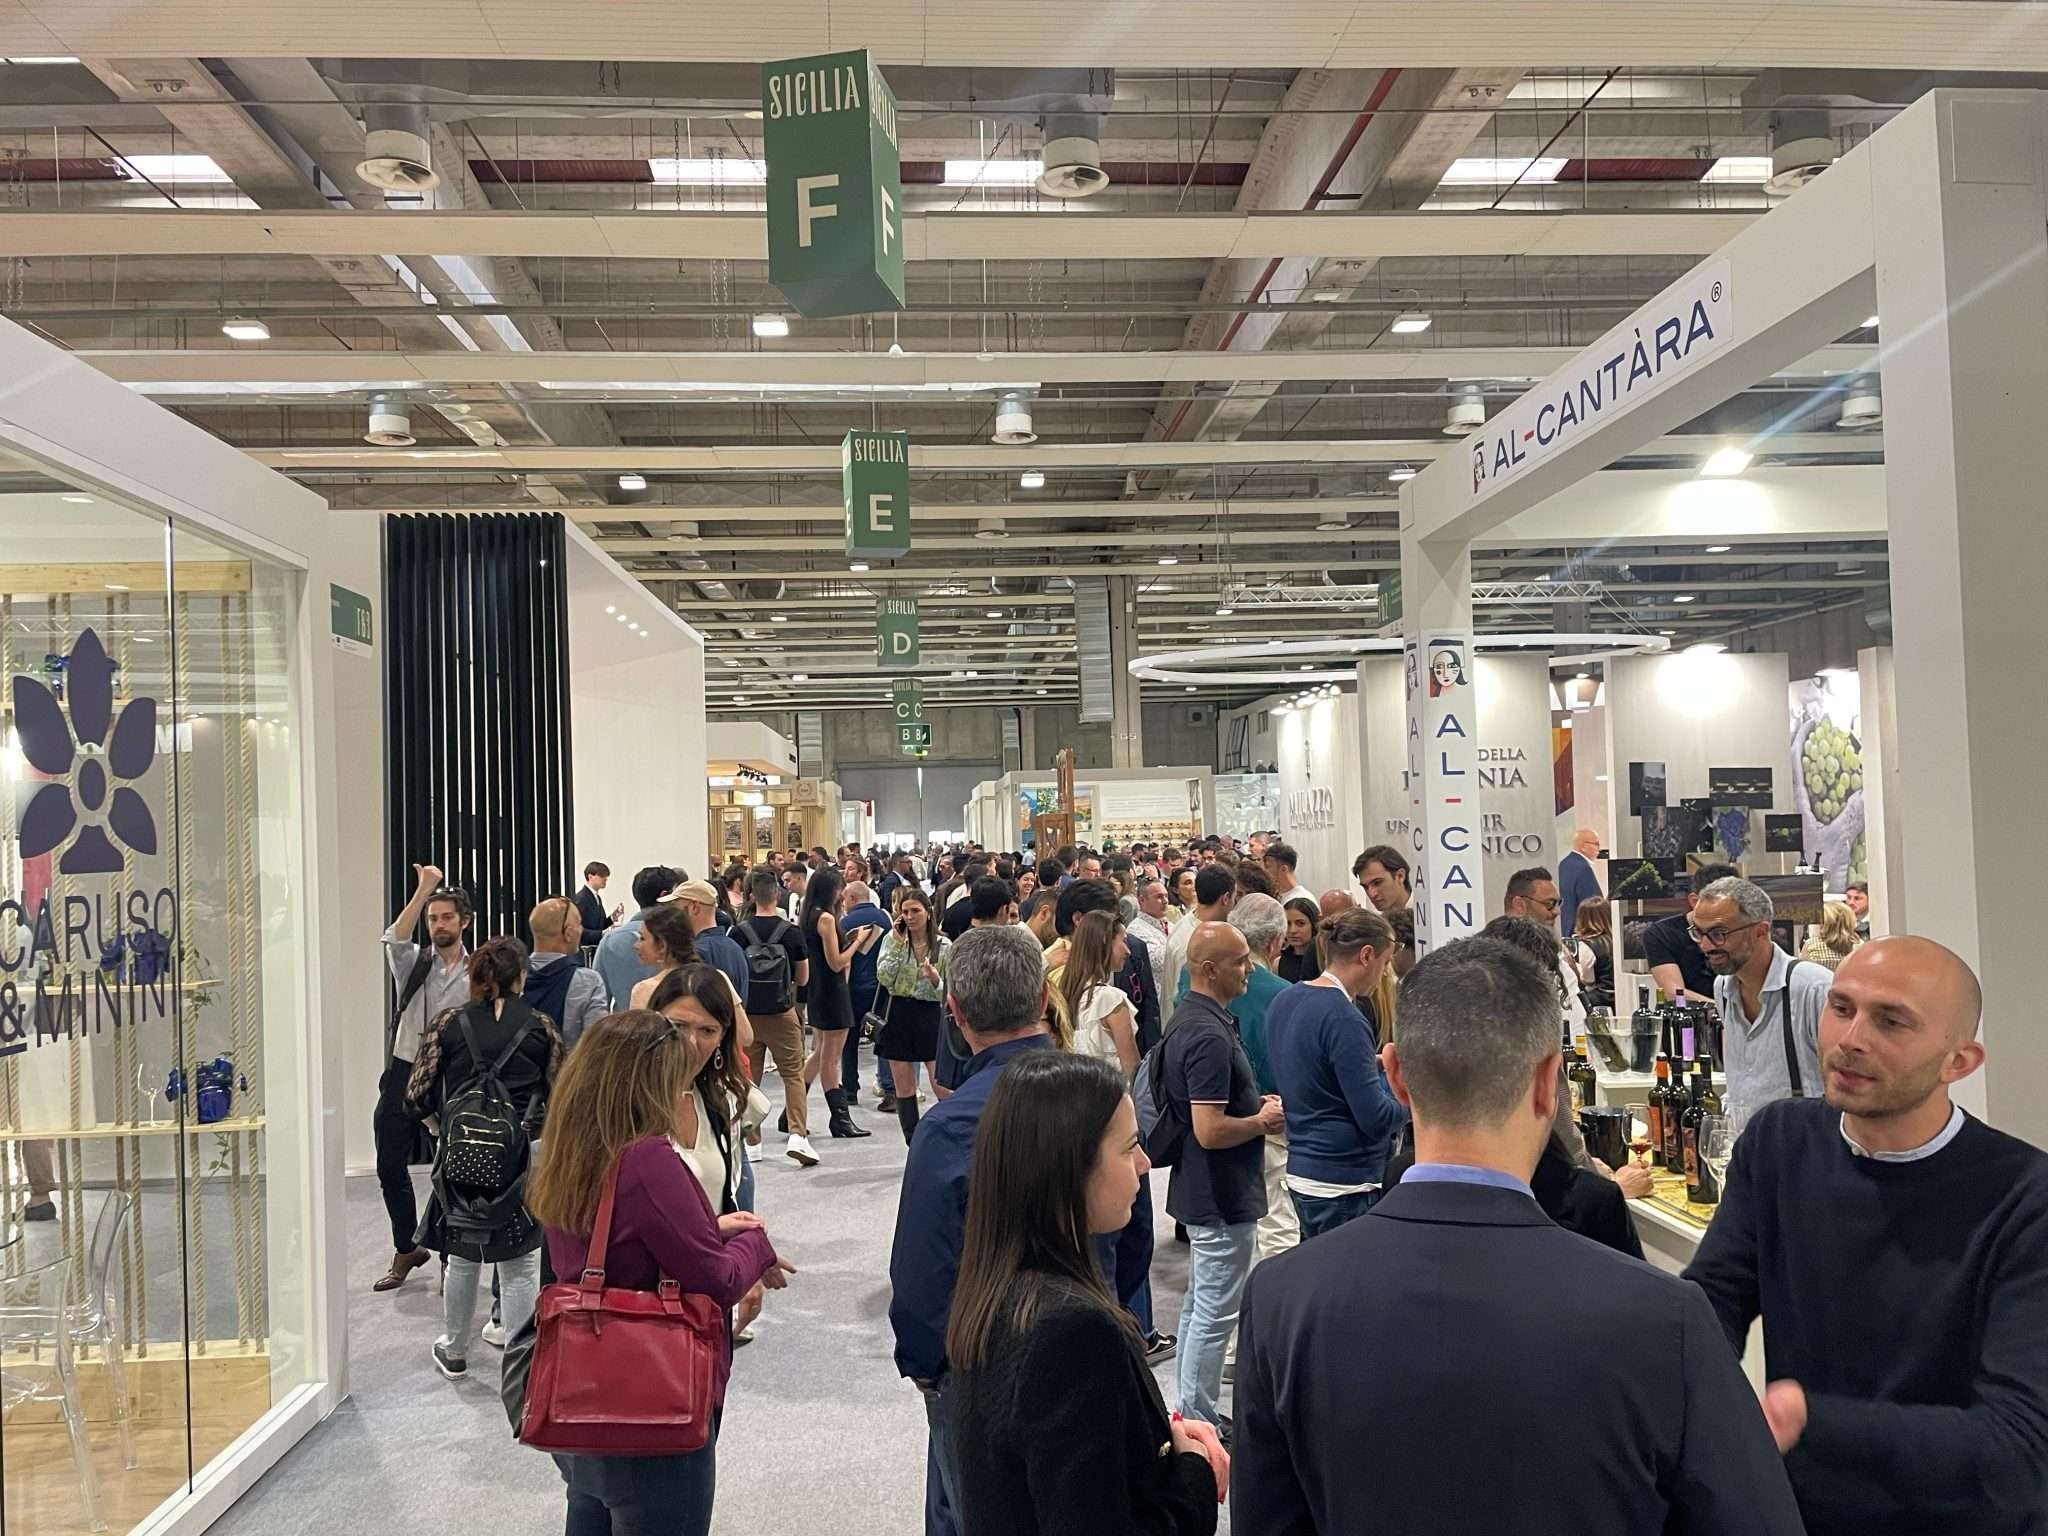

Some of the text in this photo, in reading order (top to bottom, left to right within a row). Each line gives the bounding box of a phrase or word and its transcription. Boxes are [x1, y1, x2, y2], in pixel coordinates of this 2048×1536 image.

[769, 66, 861, 119] SICILIA
[797, 174, 839, 247] F
[881, 185, 894, 256] F
[854, 438, 905, 463] SICILIA
[869, 494, 894, 531] E
[887, 599, 917, 615] SICILIA
[893, 632, 911, 654] D
[896, 702, 910, 718] C
[902, 728, 911, 740] B
[0, 887, 177, 972] CARUSO
[35, 956, 177, 1048] MININI
